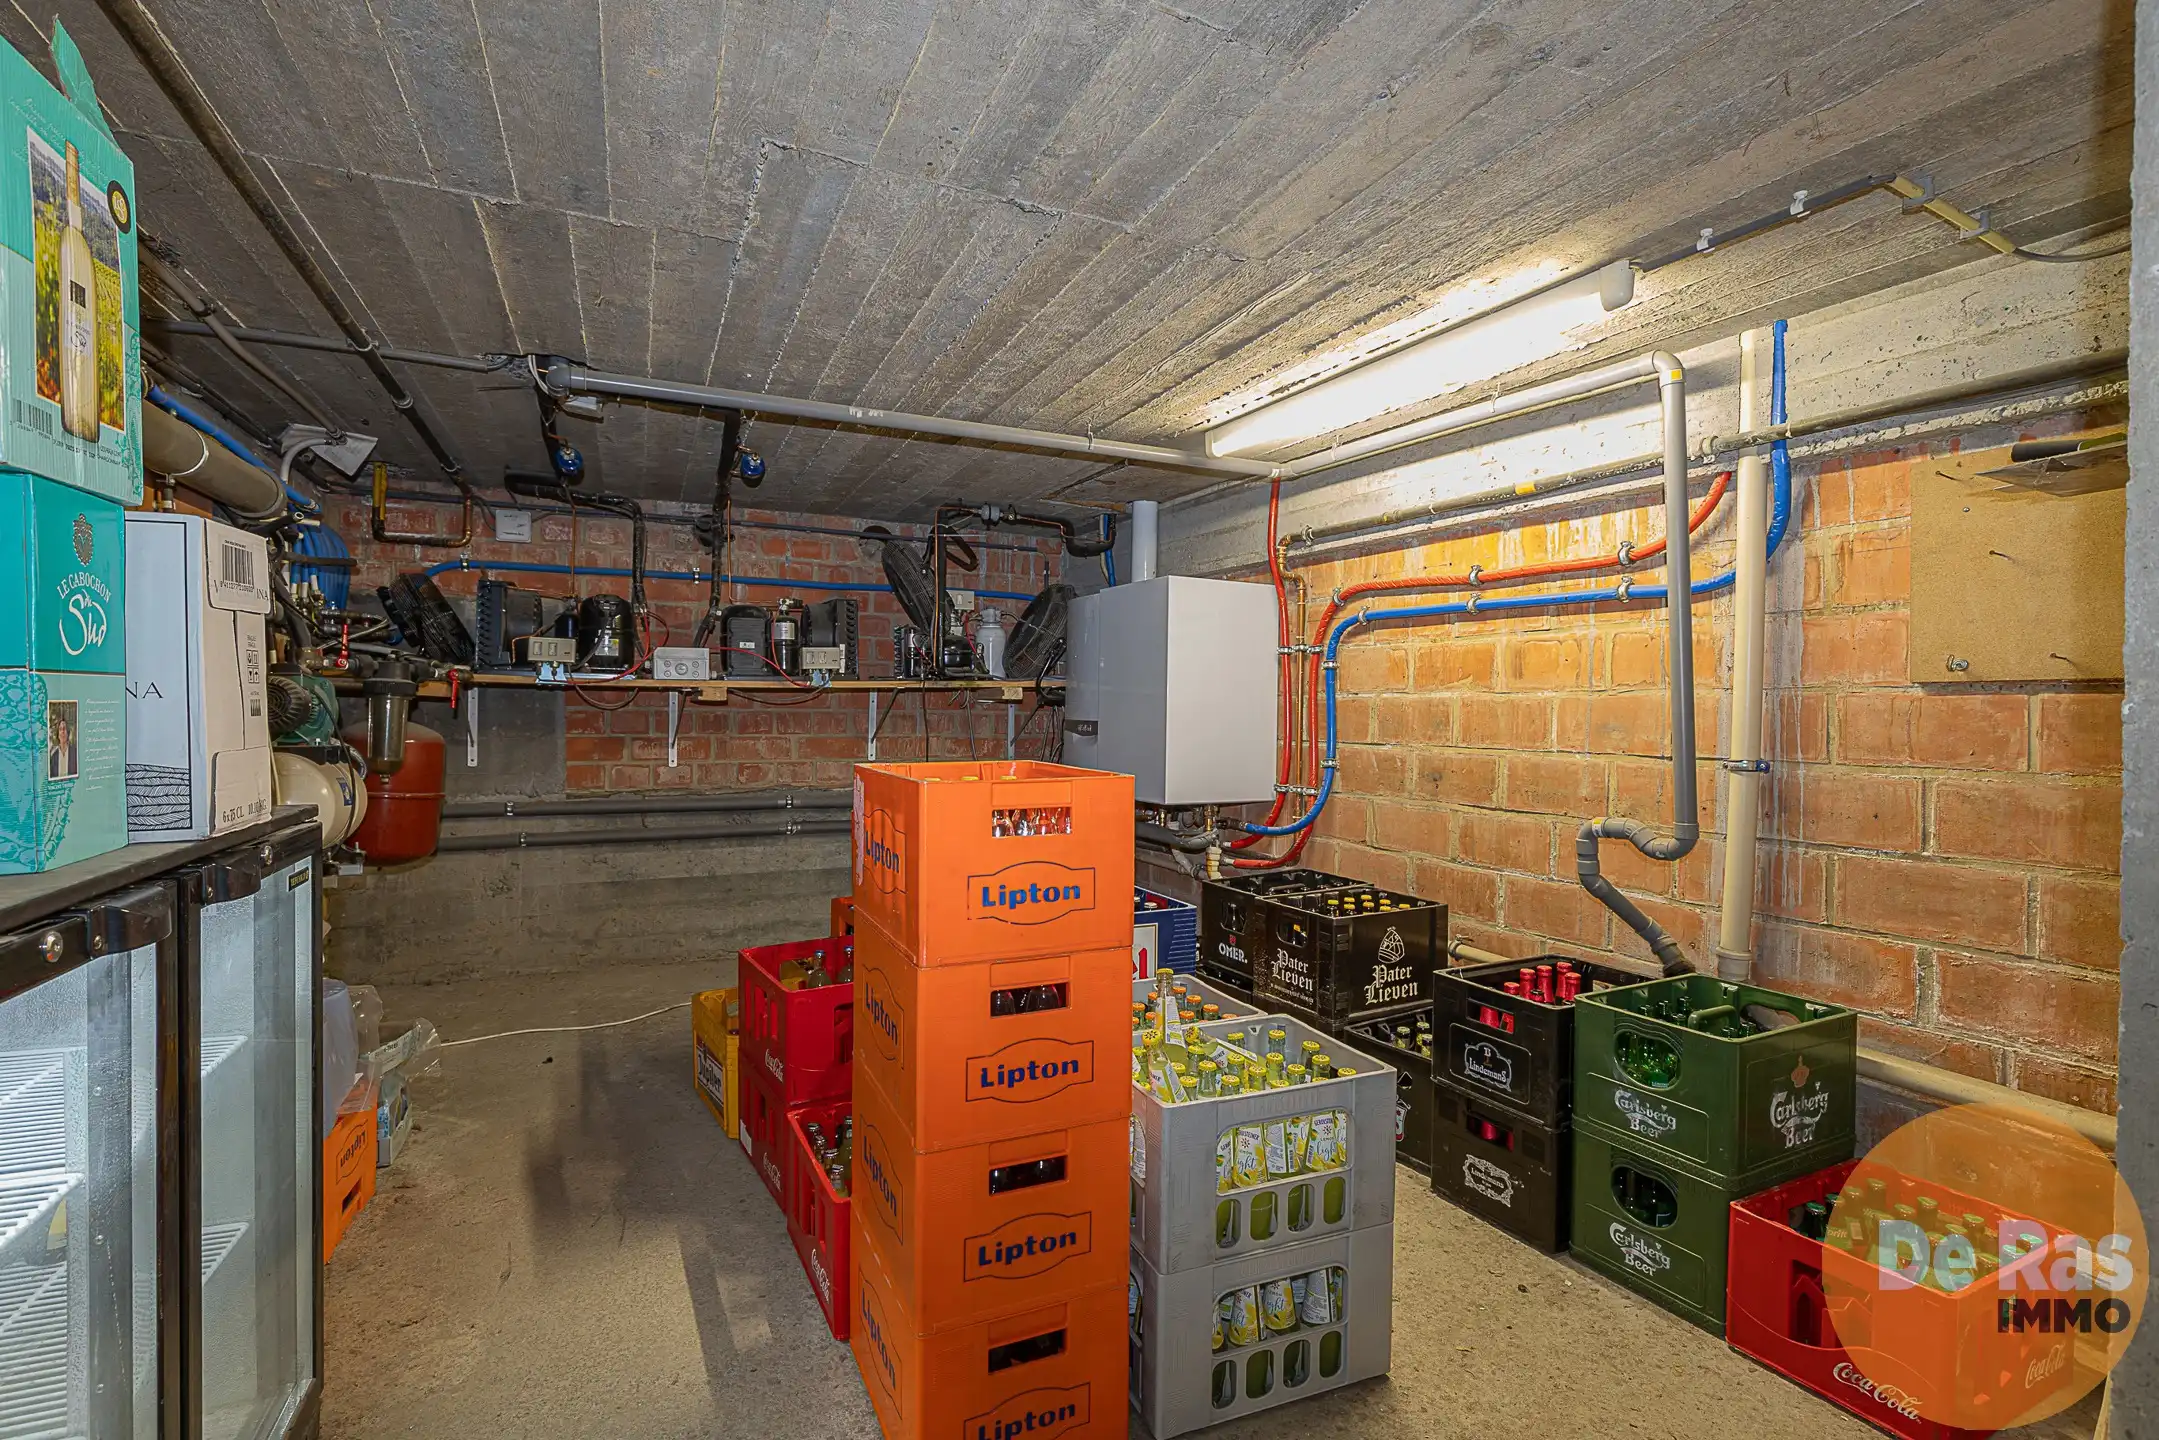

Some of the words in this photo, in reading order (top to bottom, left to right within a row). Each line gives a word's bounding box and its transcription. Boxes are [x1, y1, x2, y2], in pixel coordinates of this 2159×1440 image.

[57, 579, 70, 599] LE
[69, 571, 111, 604] CABOCHON
[865, 830, 900, 874] Lipton
[981, 882, 1081, 910] Lipton
[1218, 942, 1248, 964] OMER.
[1277, 948, 1309, 974] Pater
[1270, 960, 1314, 992] Lieven
[1372, 964, 1413, 989] Pater
[1363, 981, 1419, 1006] Lieven
[864, 984, 899, 1047] Lipton
[980, 1058, 1080, 1090] Lipton
[1629, 1117, 1662, 1139] Beer
[1784, 1125, 1816, 1149] Beer
[863, 1136, 898, 1218] Lipton
[977, 1229, 1078, 1267] Lipton
[1609, 1221, 1671, 1270] Carlsberg
[1624, 1253, 1657, 1277] Beer
[860, 1286, 897, 1392] Lipton
[1832, 1361, 1923, 1421] Coca-Cola
[978, 1402, 1076, 1440] Lipton
